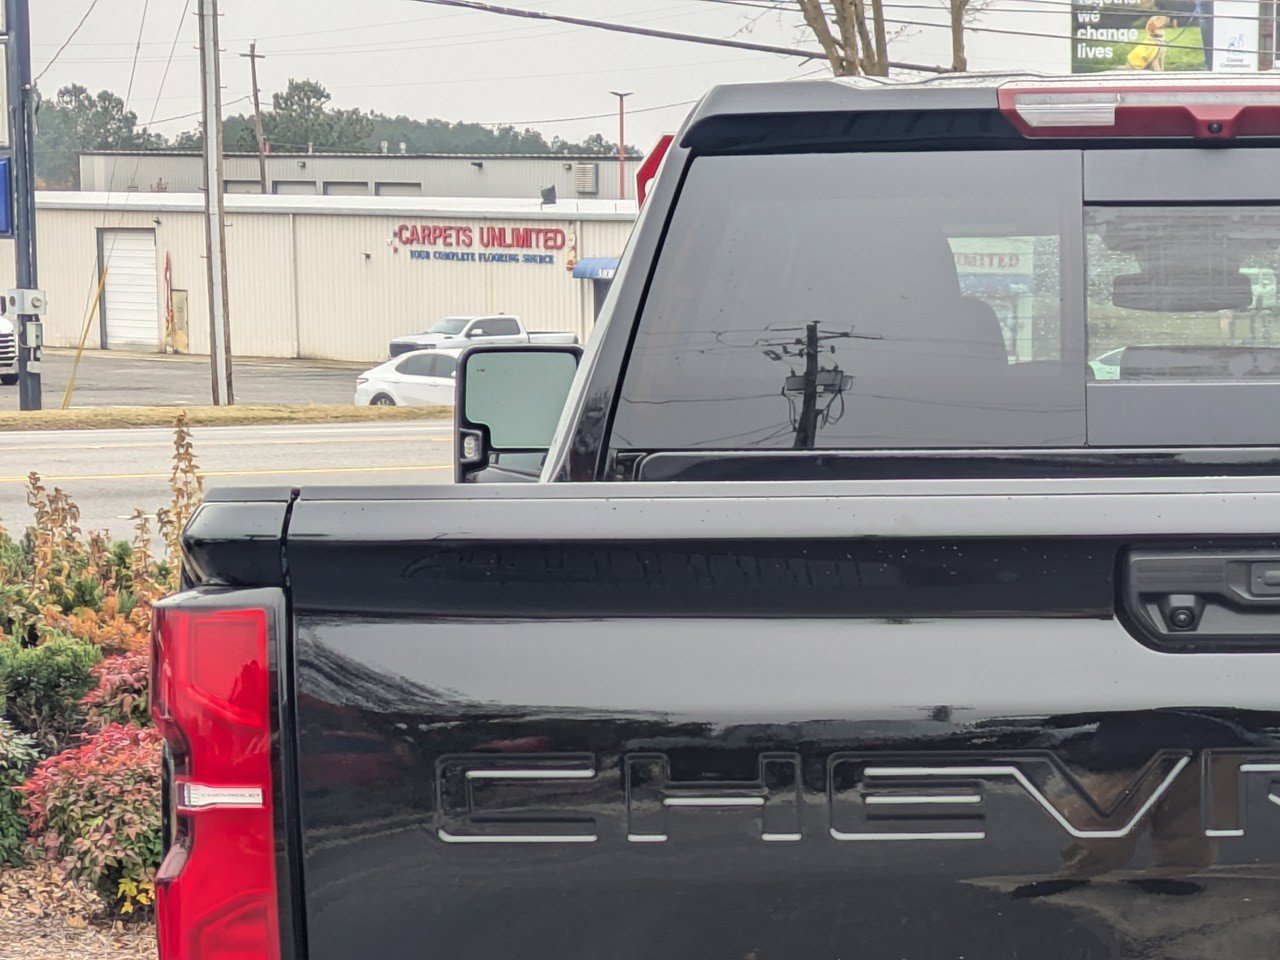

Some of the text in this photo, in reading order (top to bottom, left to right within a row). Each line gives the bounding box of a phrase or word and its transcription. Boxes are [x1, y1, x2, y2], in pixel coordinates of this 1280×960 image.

[1077, 11, 1100, 22] we
[1077, 26, 1138, 42] change
[1077, 43, 1114, 58] lives
[398, 224, 566, 251] CARPETS UNLIMITED
[410, 250, 430, 260] YOUR
[433, 251, 476, 262] COMPLETE
[478, 252, 519, 263] FLOORING
